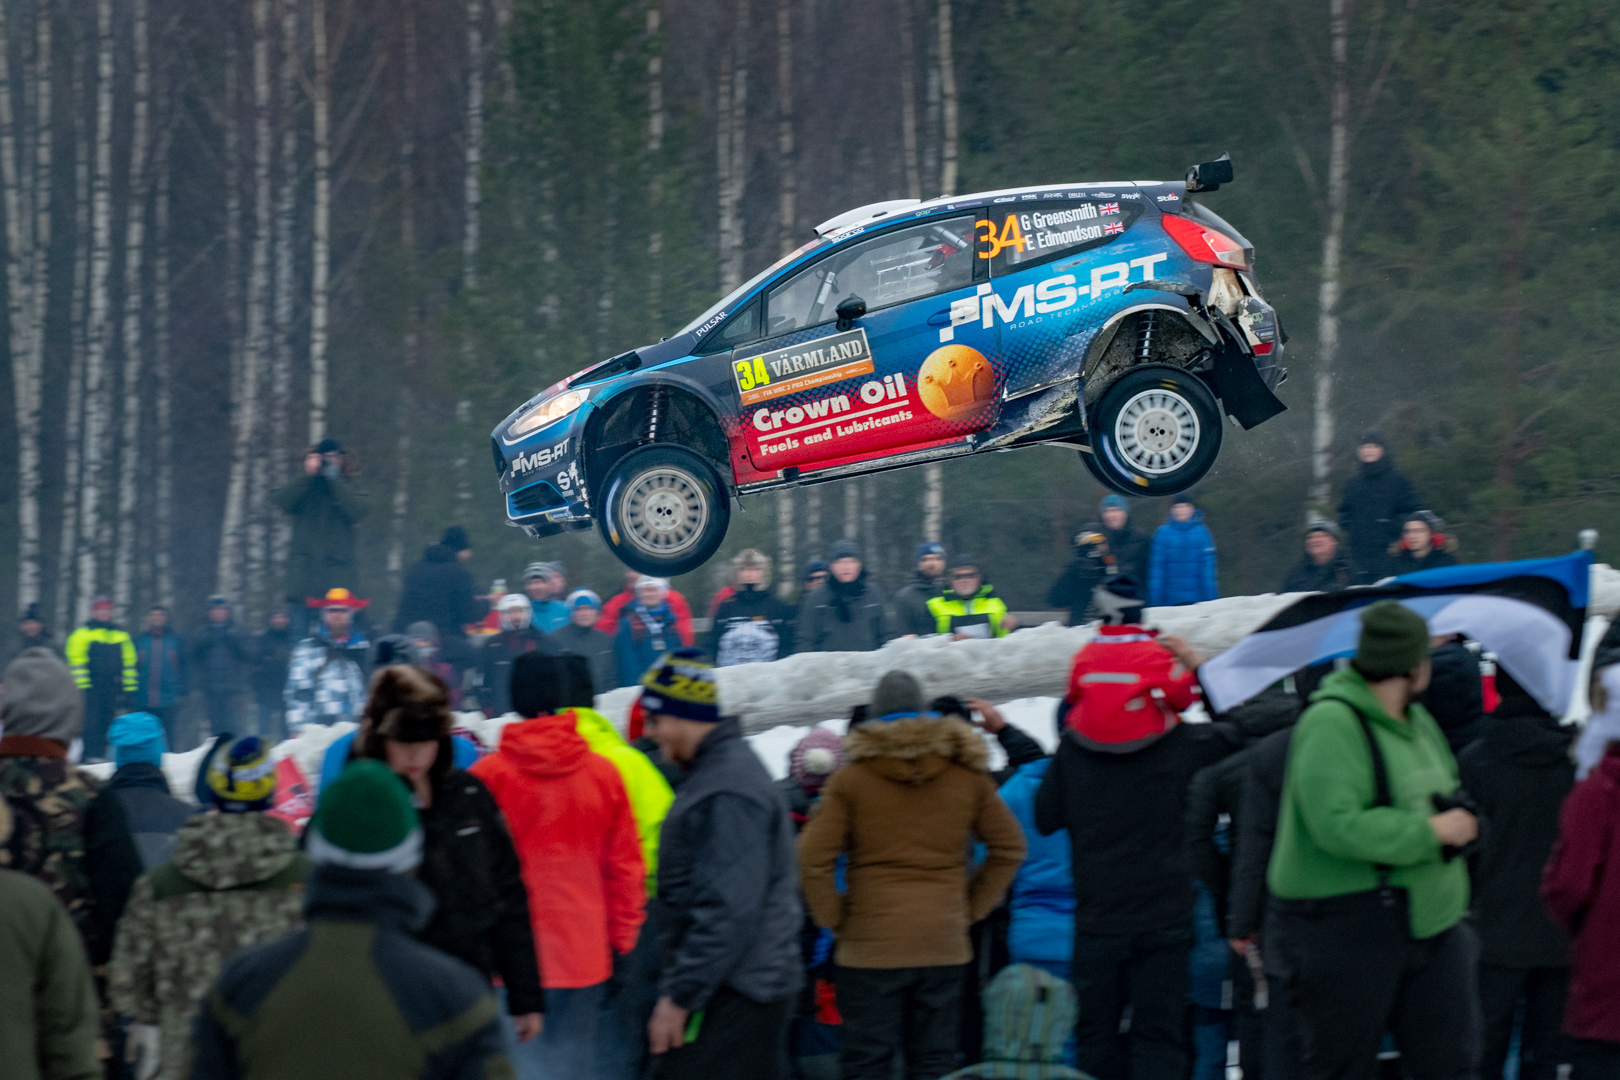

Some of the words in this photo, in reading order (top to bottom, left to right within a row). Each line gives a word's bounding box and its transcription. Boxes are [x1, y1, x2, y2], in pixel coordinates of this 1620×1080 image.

[1021, 213, 1032, 231] G
[1032, 203, 1098, 227] Greensmith
[974, 214, 1027, 259] 34
[1026, 233, 1036, 251] E
[1037, 223, 1102, 250] Edmondson
[695, 311, 728, 337] PULSAR
[1010, 317, 1043, 330] ROAD
[736, 356, 770, 391] 34
[770, 339, 863, 378] VÄRMLAND
[763, 389, 773, 397] FIA
[804, 371, 843, 387] Championship
[752, 393, 851, 432] Crown
[860, 372, 908, 405] Oil
[760, 437, 800, 456] Fuels
[804, 428, 833, 445] and
[836, 409, 913, 437] Lubricants
